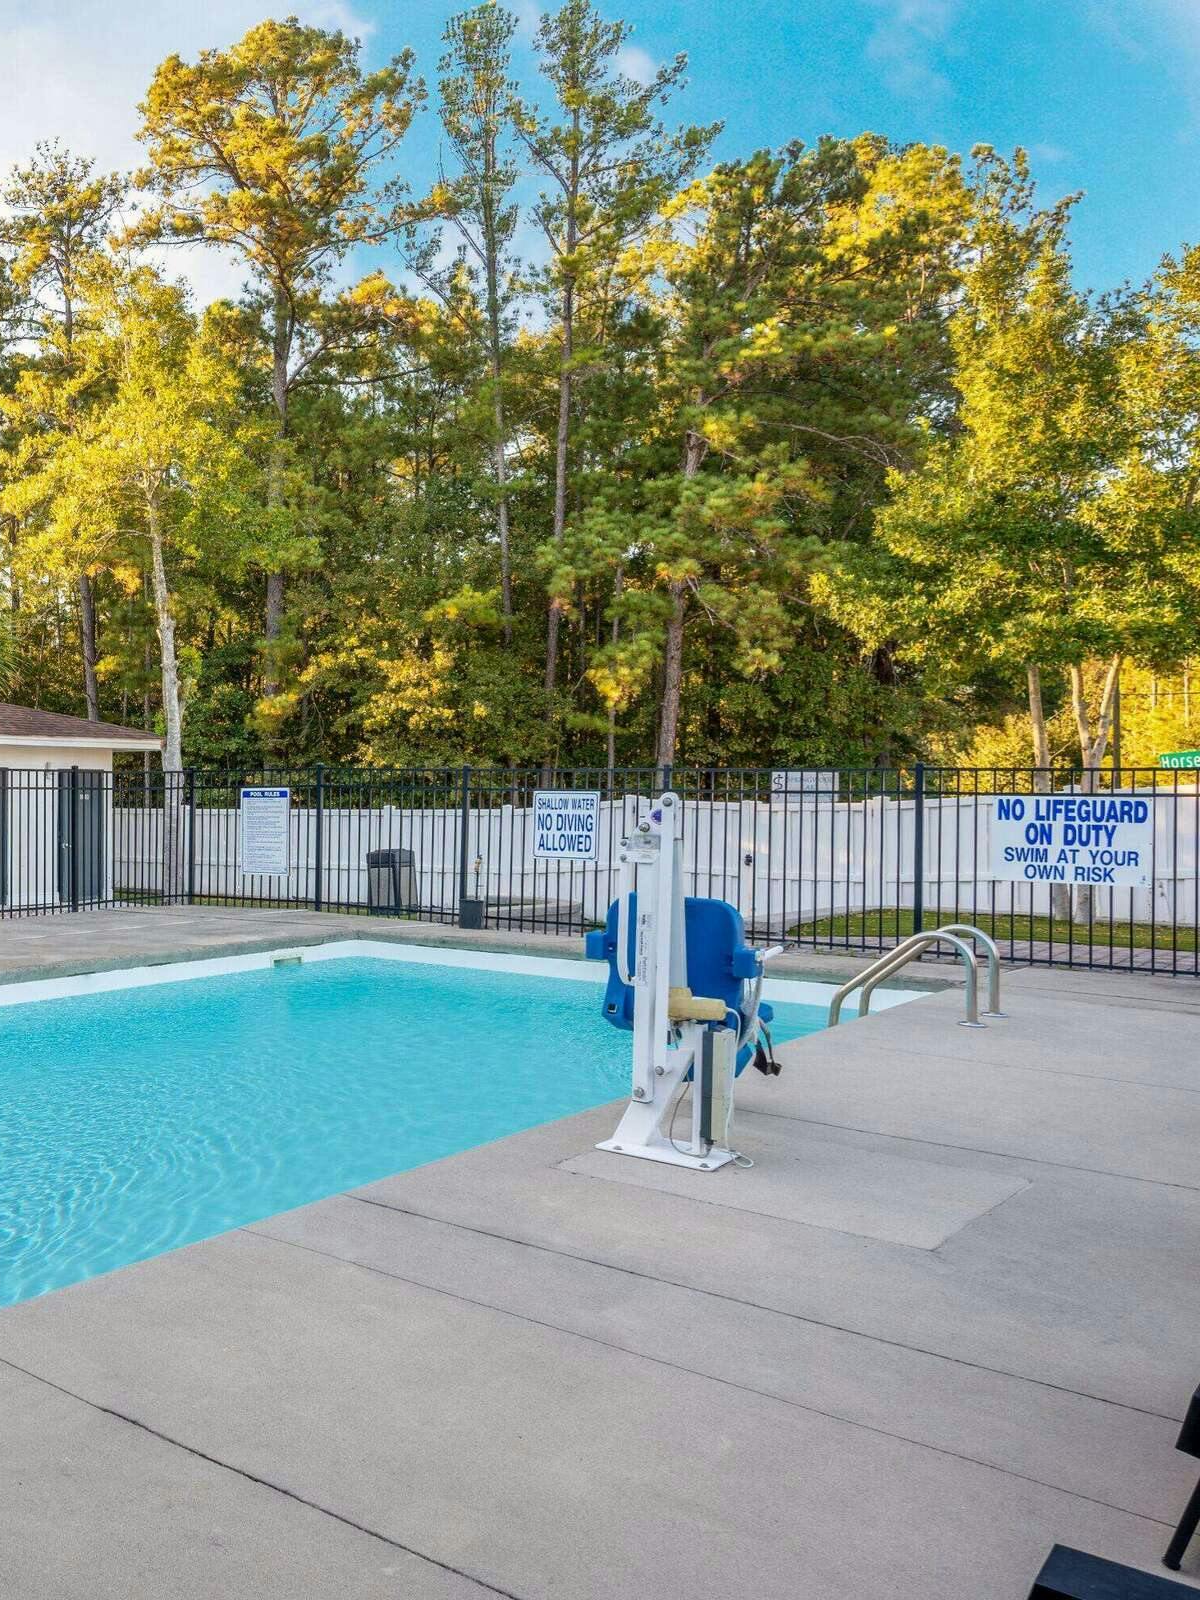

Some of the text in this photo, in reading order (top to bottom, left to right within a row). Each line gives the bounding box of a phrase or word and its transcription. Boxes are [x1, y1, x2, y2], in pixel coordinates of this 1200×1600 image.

[537, 798, 595, 811] SHALLOW WATER
[998, 798, 1148, 823] NO LIFEGUARD
[537, 813, 594, 832] NO DIVING
[537, 833, 592, 852] ALLOWED
[1025, 822, 1117, 847] ON DUTY
[1004, 847, 1139, 867] SWIM AT YOUR
[1024, 864, 1115, 882] OWN RISK
